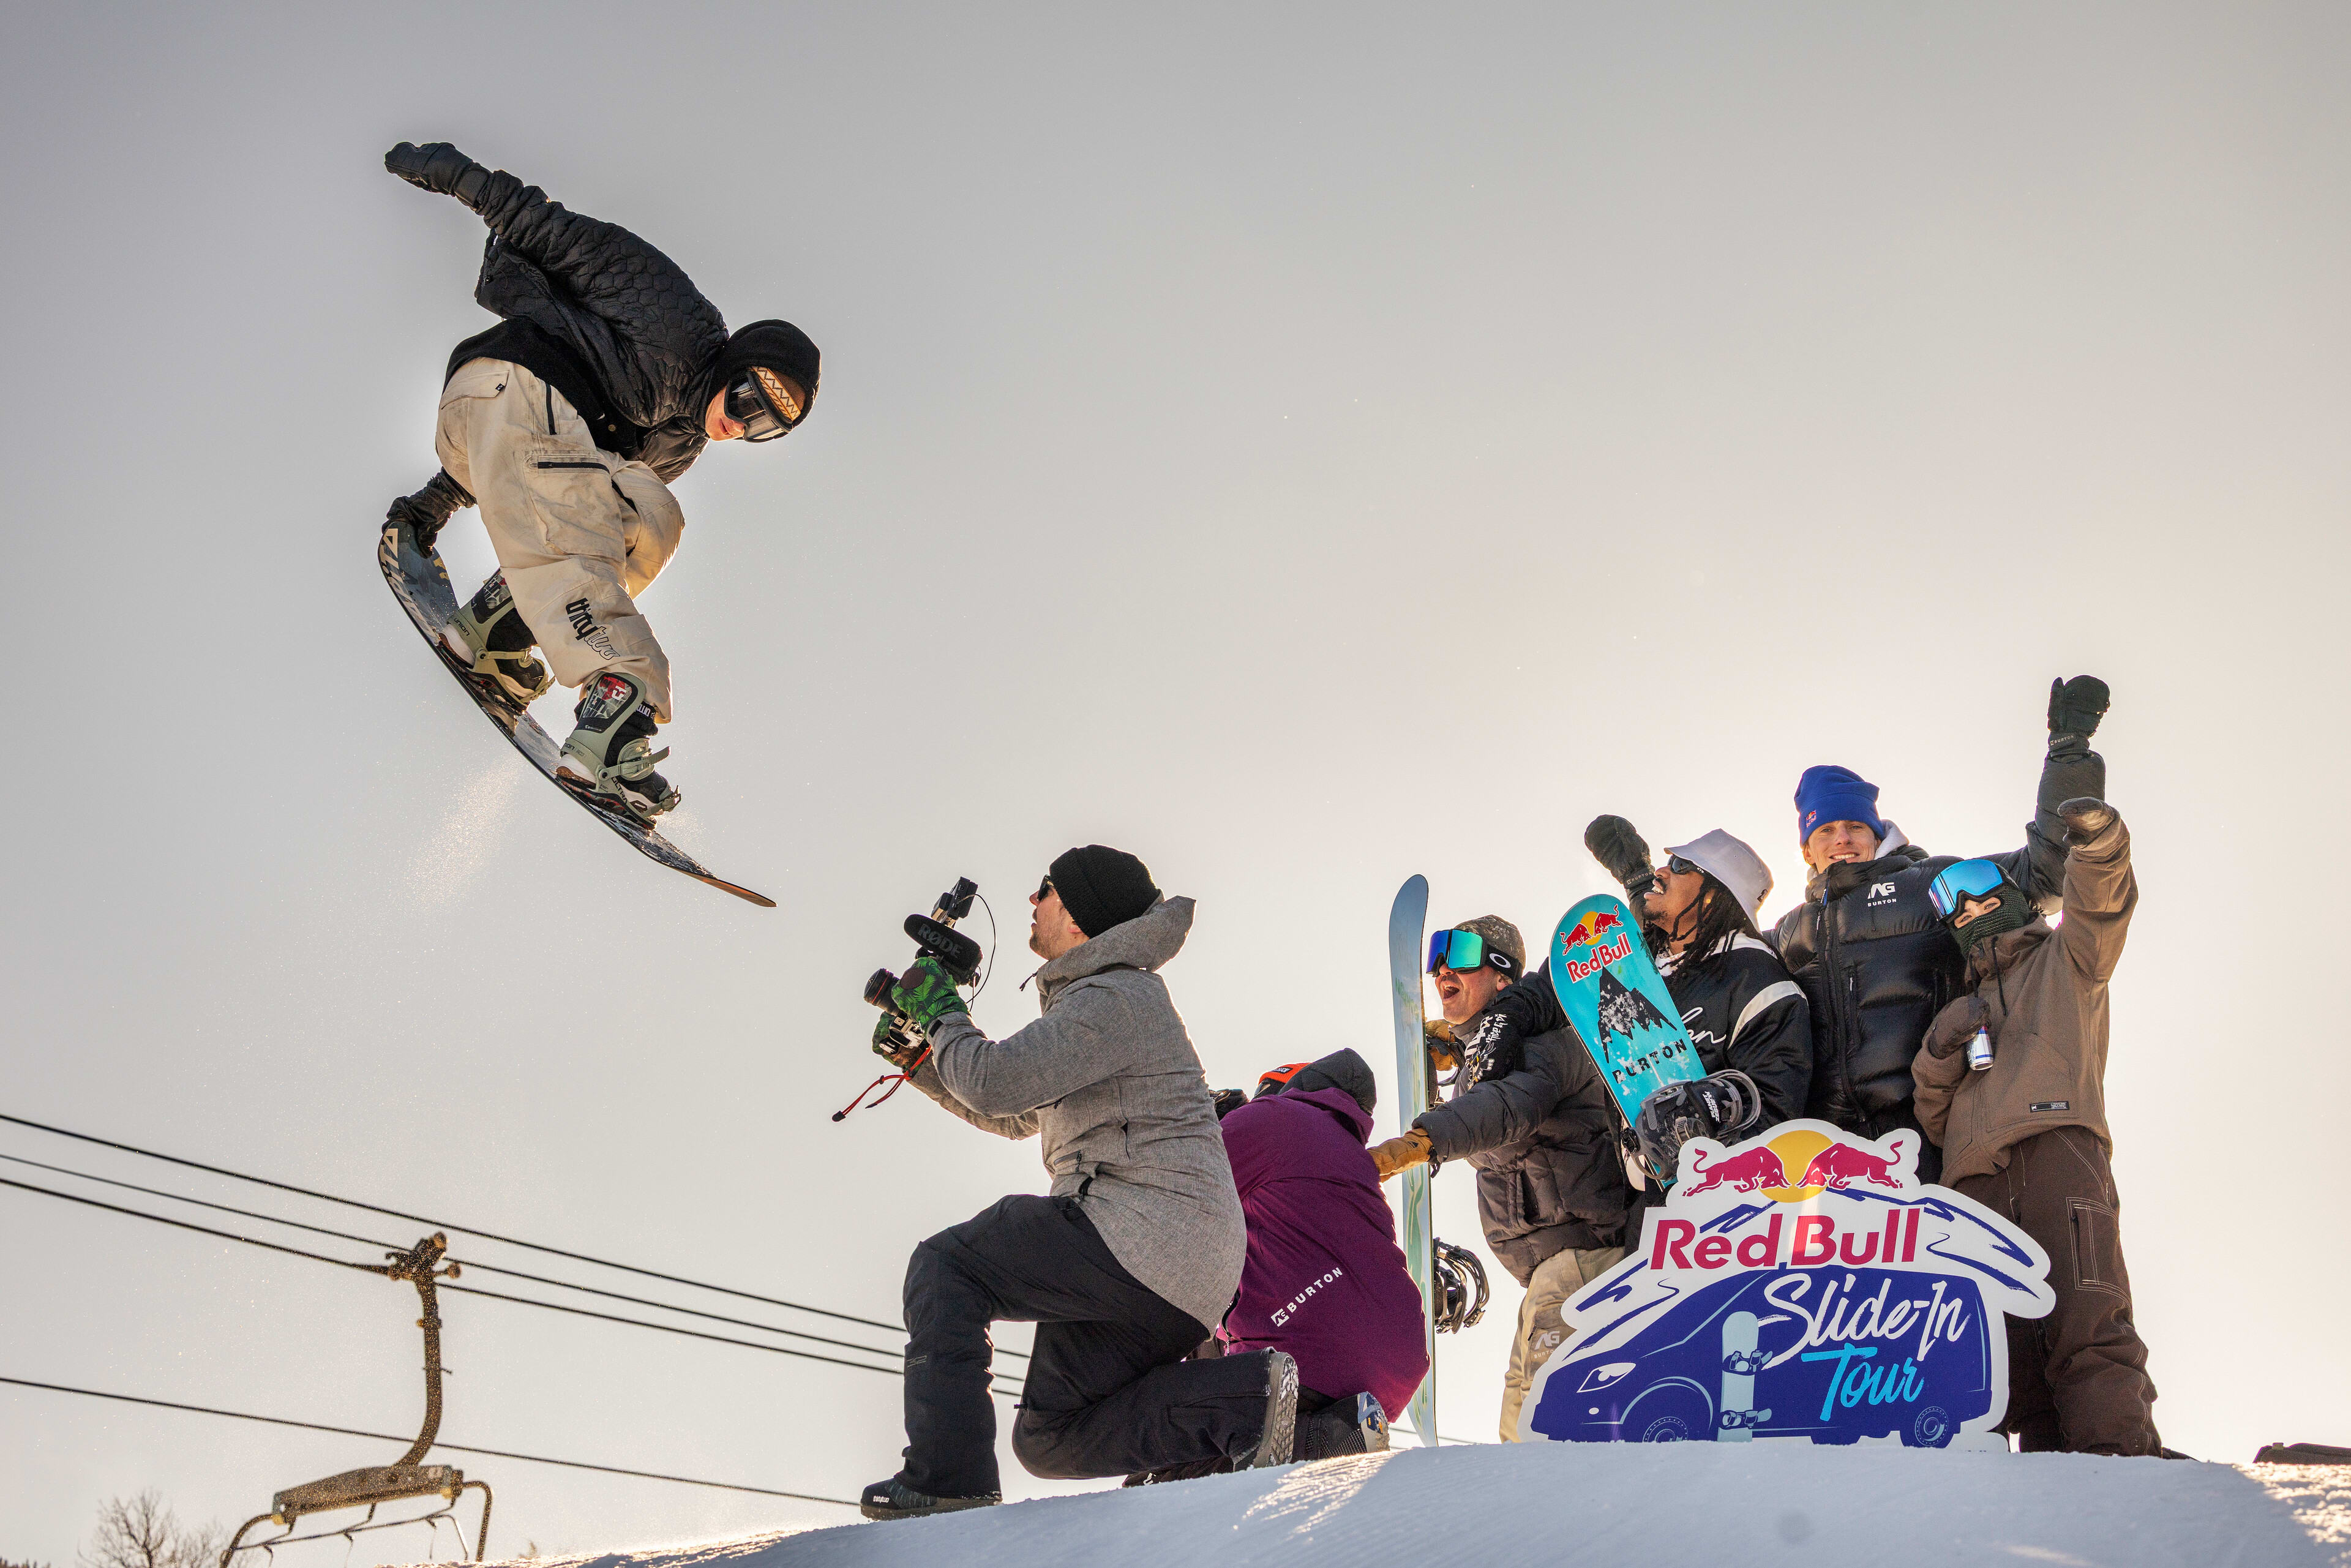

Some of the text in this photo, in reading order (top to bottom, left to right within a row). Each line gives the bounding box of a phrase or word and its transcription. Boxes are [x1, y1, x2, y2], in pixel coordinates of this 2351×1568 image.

[2054, 735, 2074, 744] BURTON
[1631, 871, 1652, 882] BURTON
[1868, 898, 1897, 907] BURTON
[1565, 932, 1633, 983] Red Bull
[1651, 1208, 1921, 1269] Red Bull
[1286, 1267, 1343, 1313] BURTON
[1758, 1273, 1971, 1370] Slide-In
[1534, 1349, 1554, 1359] BURTO
[1801, 1343, 1924, 1421] Tour
